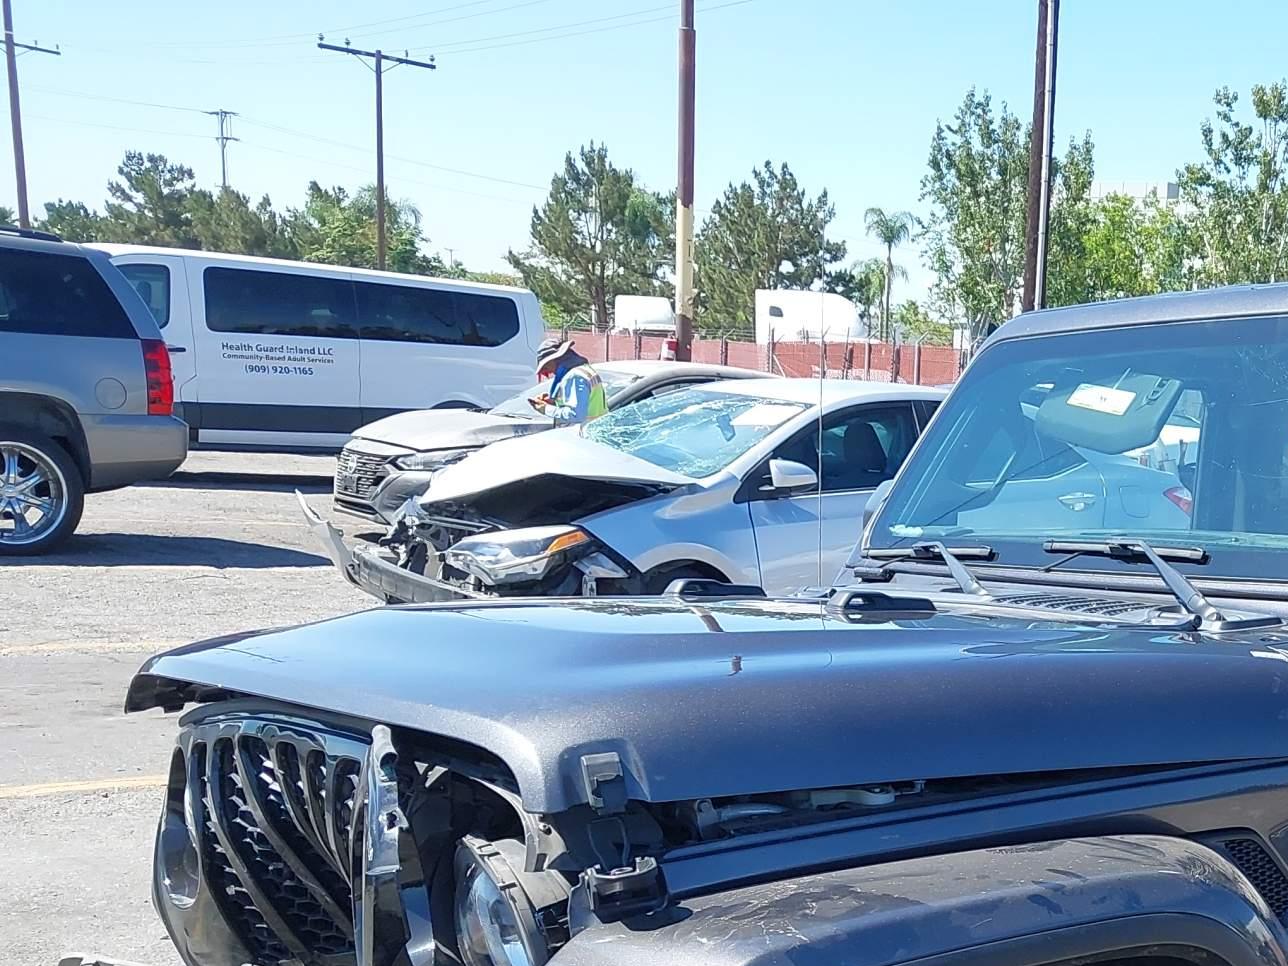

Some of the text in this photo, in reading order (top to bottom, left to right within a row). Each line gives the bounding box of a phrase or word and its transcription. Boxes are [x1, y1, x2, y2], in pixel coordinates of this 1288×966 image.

[221, 342, 334, 356] Health Guard Inland LLC
[222, 352, 334, 364] Community-Based Adult Services
[245, 364, 314, 376] (909) 920-1165
